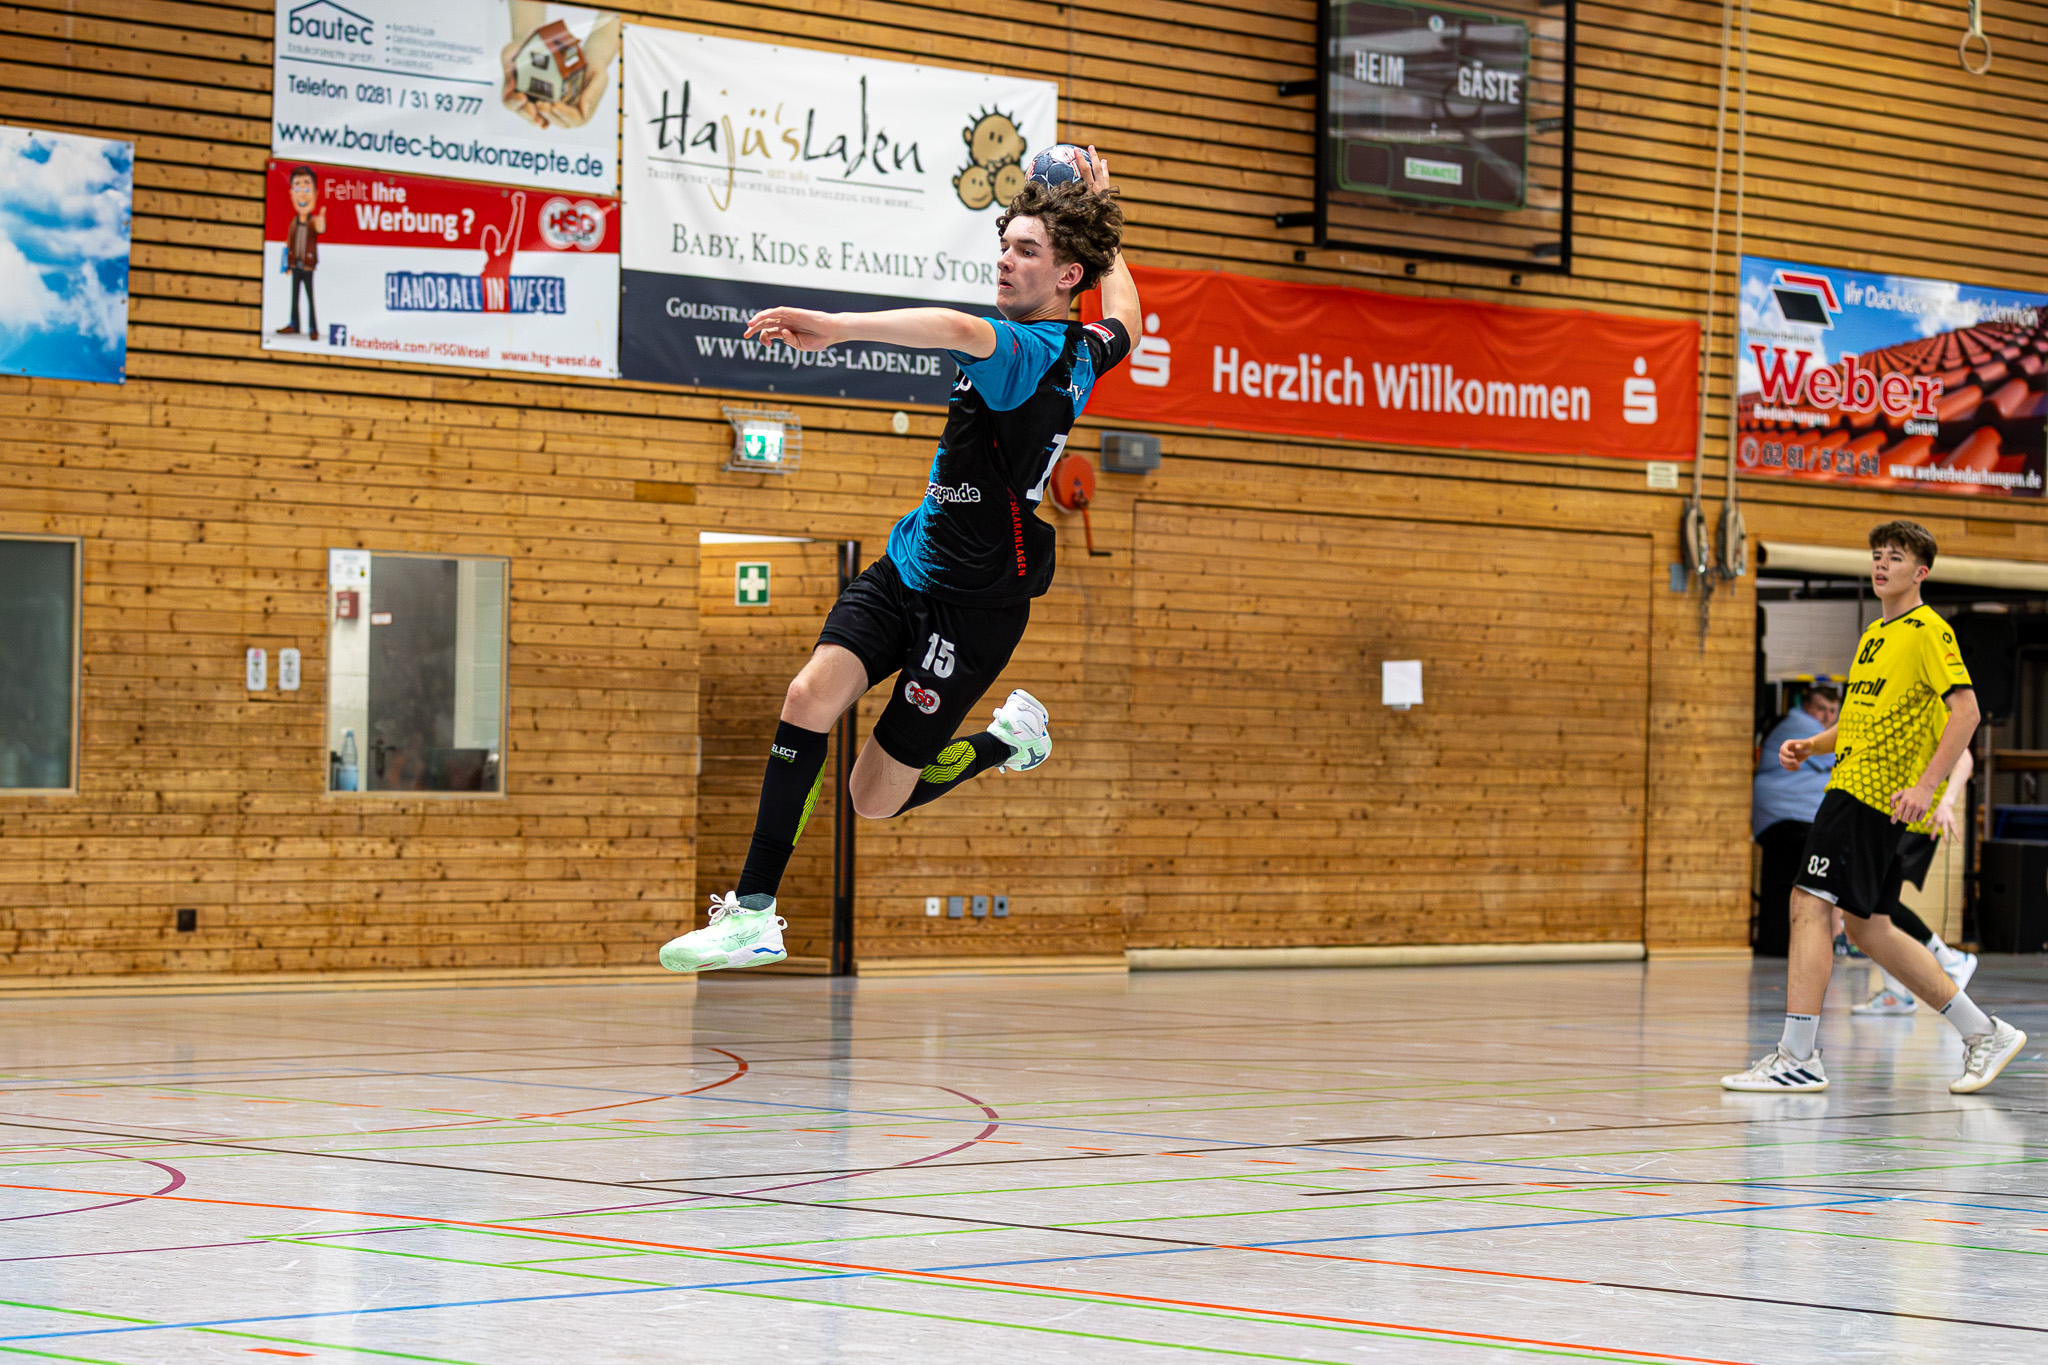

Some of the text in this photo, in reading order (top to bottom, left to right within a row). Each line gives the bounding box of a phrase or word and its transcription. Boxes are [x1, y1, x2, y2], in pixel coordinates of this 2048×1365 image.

[289, 12, 374, 46] bautec
[288, 74, 348, 100] Telefon
[356, 83, 392, 105] 0281
[410, 90, 428, 109] 31
[1354, 50, 1520, 104] HEIM GÄSTE
[278, 122, 603, 177] www.bautec-baukonzepte.de
[324, 178, 407, 204] Fehlt Ihre
[550, 209, 596, 234] HSG
[672, 222, 998, 286] BABY, KIDS & FAMILY STOR
[386, 274, 565, 312] HANDBALL IN WESEL
[350, 335, 490, 359] facebook.com/HSGWesel
[502, 350, 602, 369] www.hsg-wesel.de
[695, 335, 941, 377] WWW.HAJUES-LADEN.DE
[1213, 344, 1591, 422] Herzlich Willkommen
[1748, 343, 1944, 420] Weber
[1753, 402, 1831, 428] Bedachungen
[1889, 461, 2042, 490] www.weberbedachungen.de
[921, 632, 955, 679] 15
[1857, 637, 1885, 665] 82
